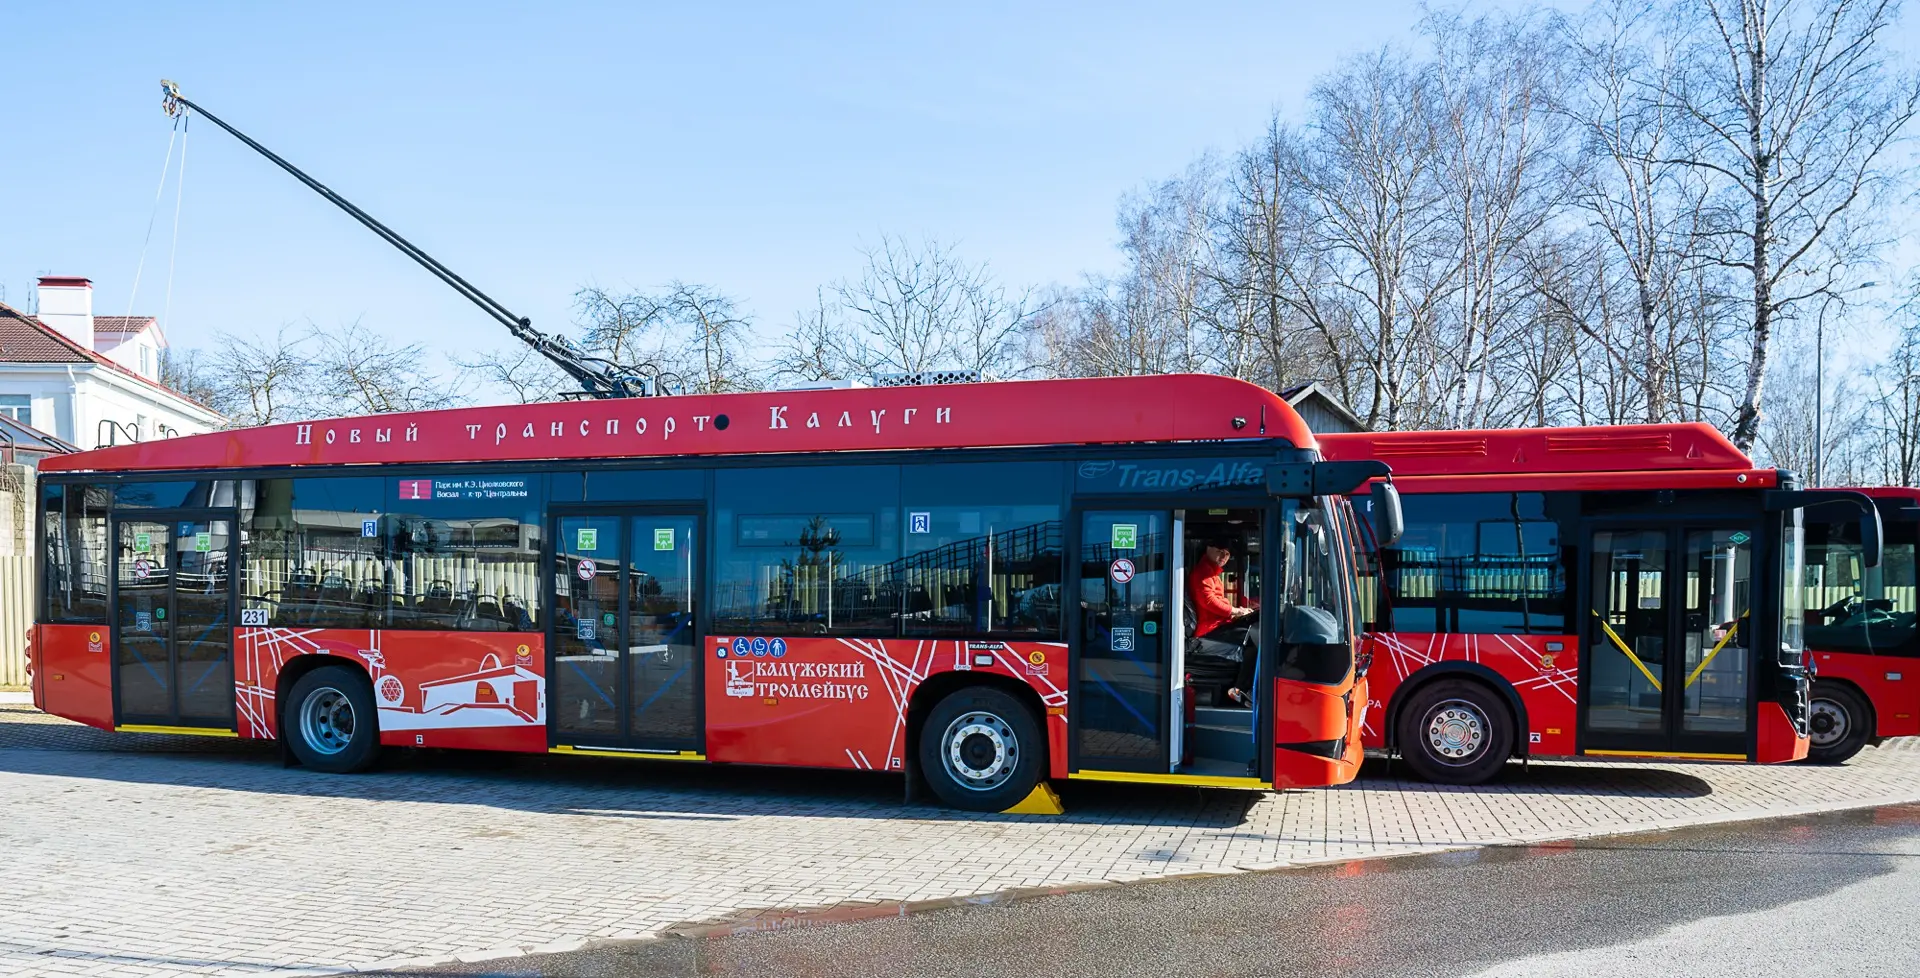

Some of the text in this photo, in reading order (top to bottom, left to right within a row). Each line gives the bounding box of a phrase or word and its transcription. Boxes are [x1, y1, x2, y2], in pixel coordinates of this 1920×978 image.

[295, 406, 951, 446] Новый транспорт Калуги
[435, 481, 452, 490] Парк
[479, 480, 524, 490] Циолковского
[1118, 461, 1264, 488] Trans-Alfa
[411, 481, 420, 499] 1
[243, 611, 265, 624] 231
[755, 660, 865, 681] КАЛУЖСКИЙ
[755, 681, 869, 703] ТРОЛЛЕЙБУС
